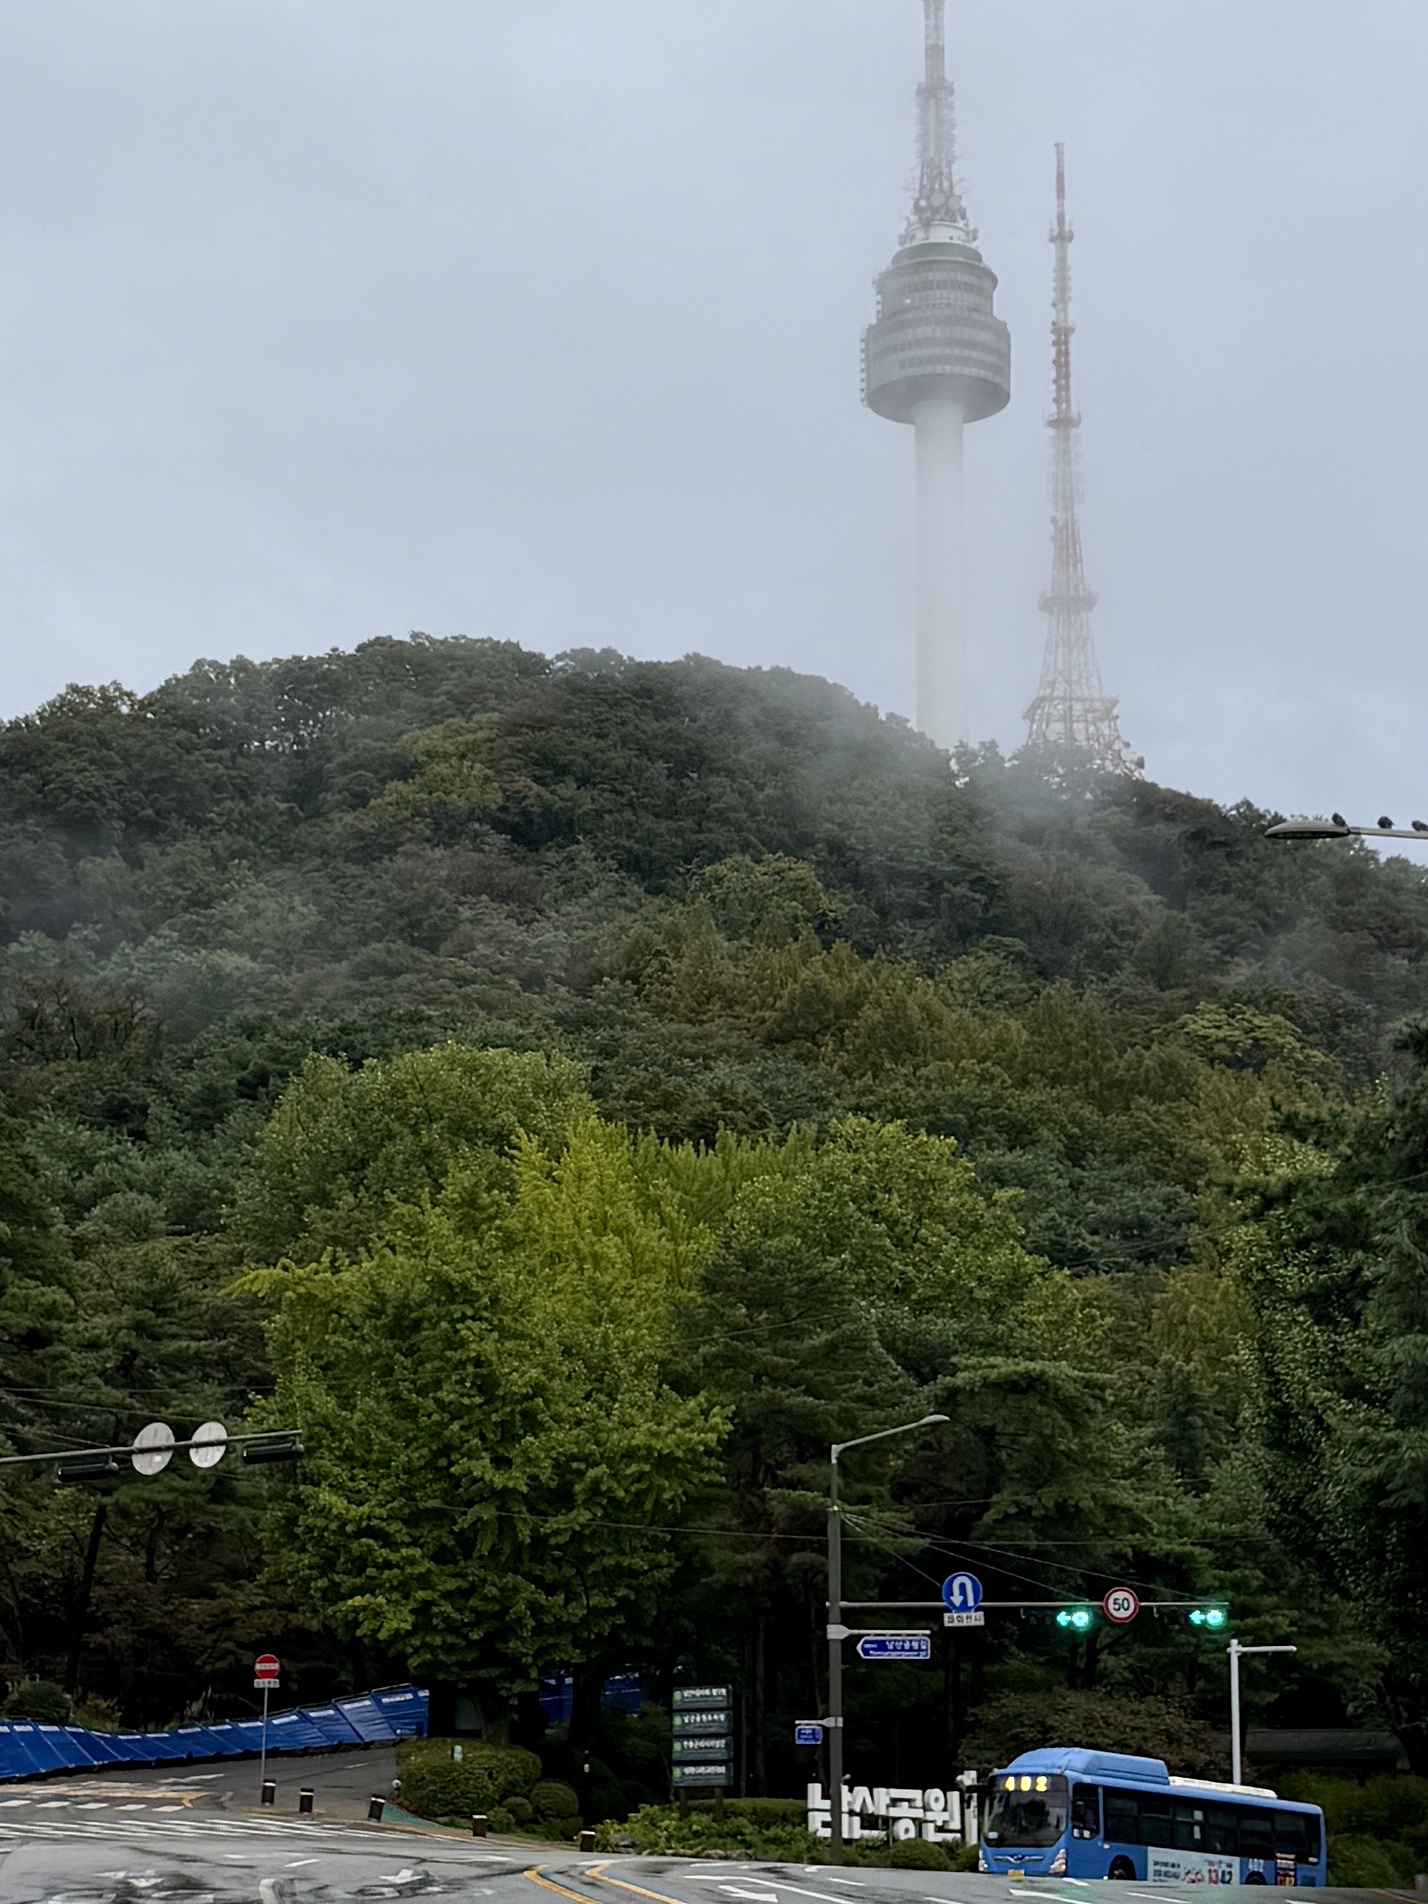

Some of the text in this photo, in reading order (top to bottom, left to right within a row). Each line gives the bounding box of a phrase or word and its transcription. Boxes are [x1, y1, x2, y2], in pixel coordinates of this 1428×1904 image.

[1112, 1597, 1131, 1612] 50
[1005, 1775, 1048, 1792] 402
[807, 1782, 962, 1844] 남산공원
